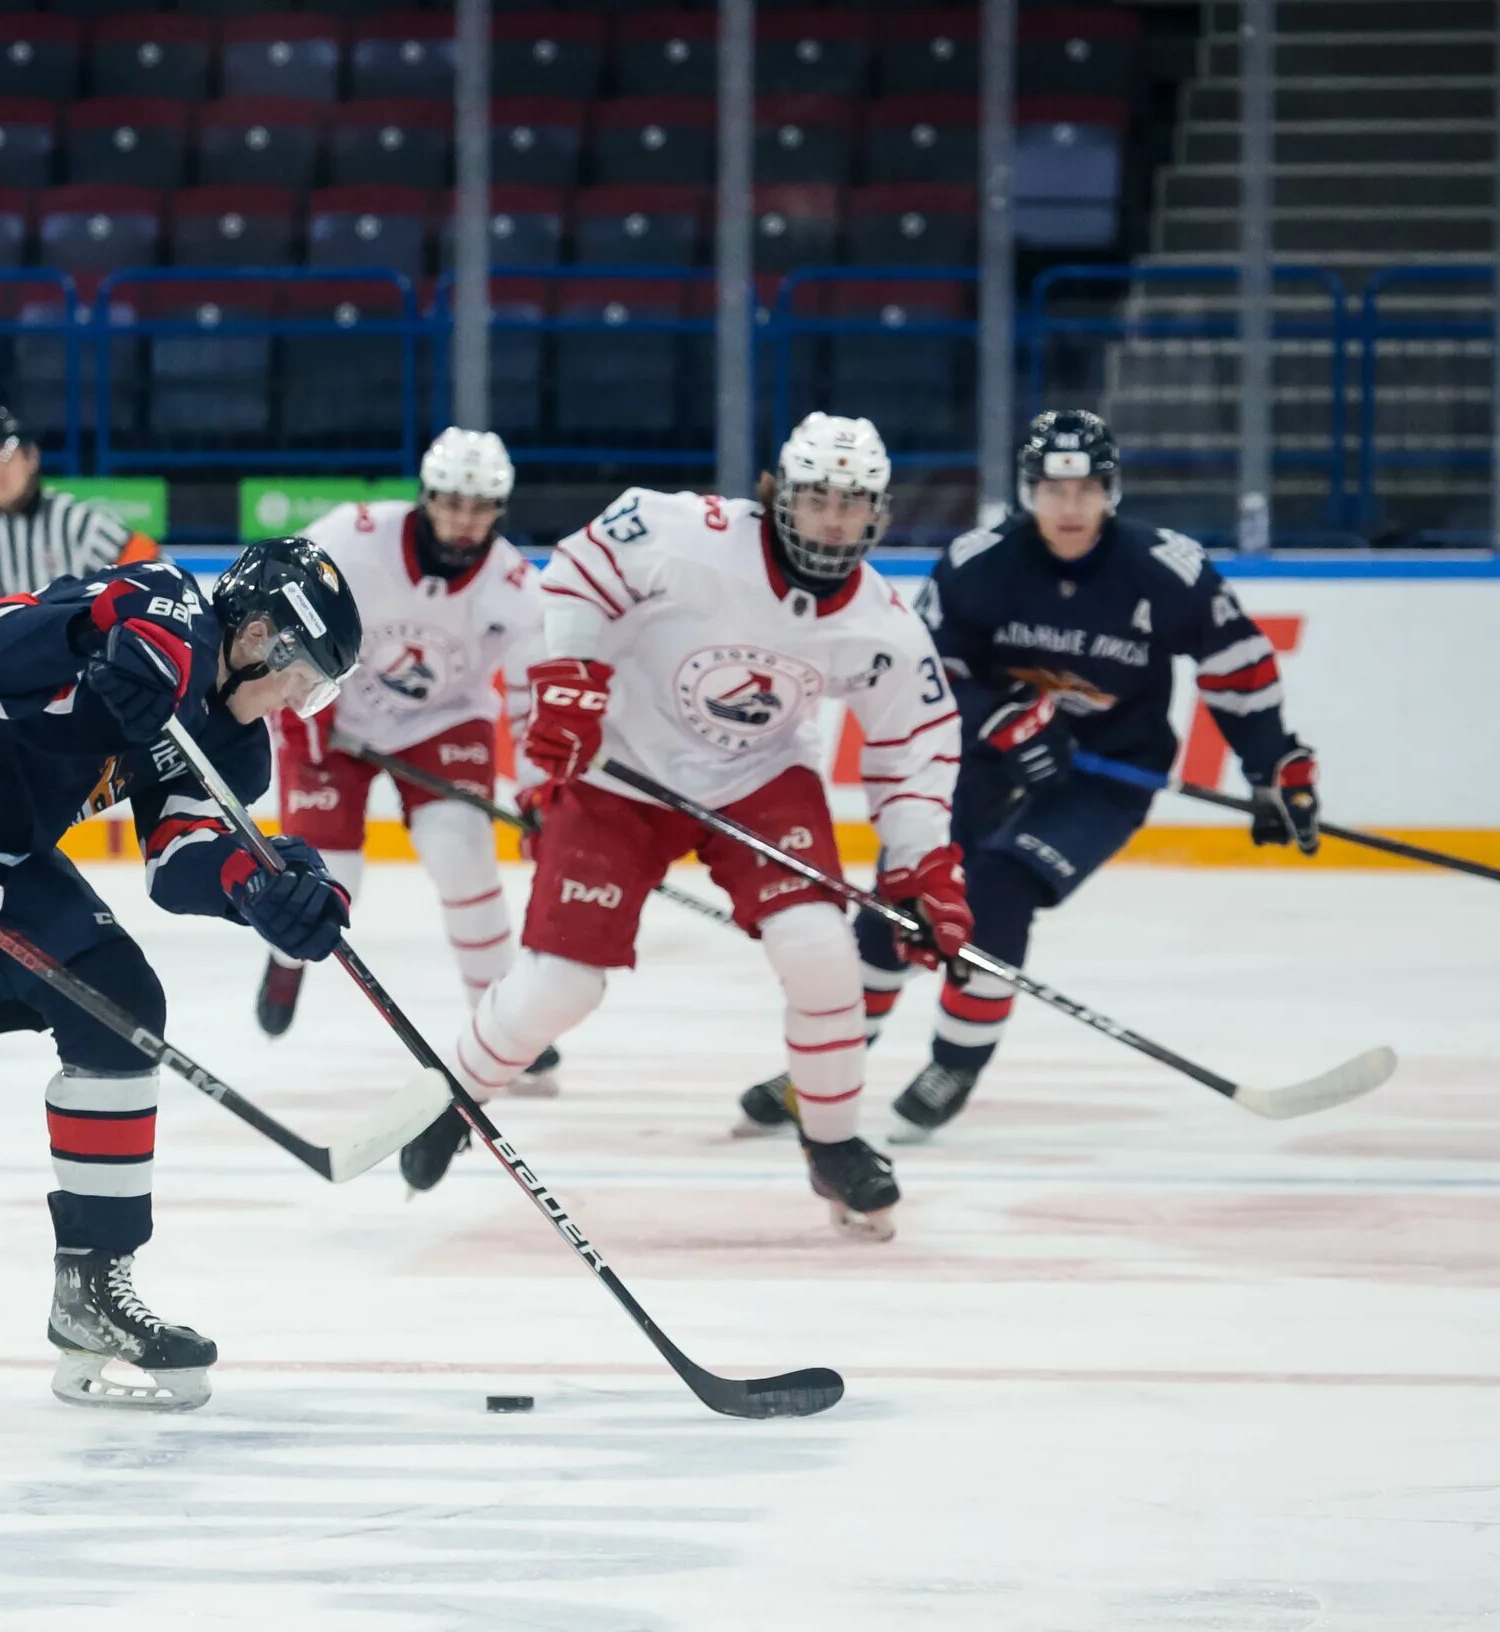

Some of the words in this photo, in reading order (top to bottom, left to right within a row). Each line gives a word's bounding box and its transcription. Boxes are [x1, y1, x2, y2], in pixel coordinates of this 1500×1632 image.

[1131, 599, 1152, 633] A
[543, 684, 609, 710] CC
[919, 656, 945, 704] 3
[131, 1027, 228, 1101] CCM
